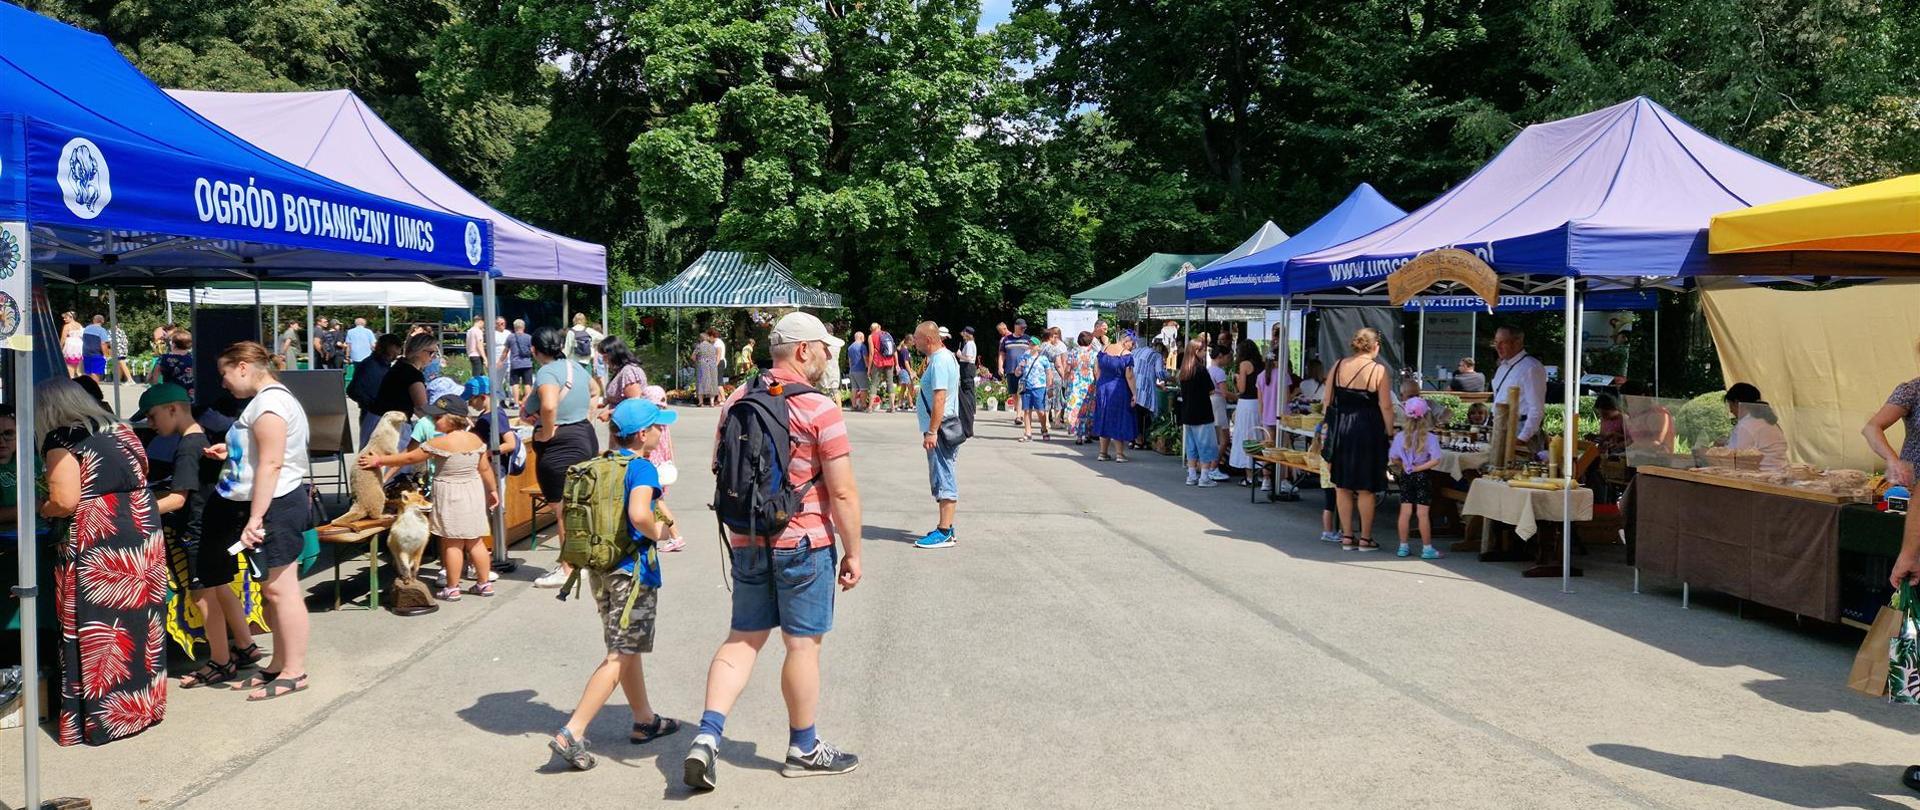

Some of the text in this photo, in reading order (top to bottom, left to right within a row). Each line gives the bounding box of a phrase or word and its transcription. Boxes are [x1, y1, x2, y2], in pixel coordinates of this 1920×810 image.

[194, 176, 435, 252] OGRÓD BOTANICZNY UMCS
